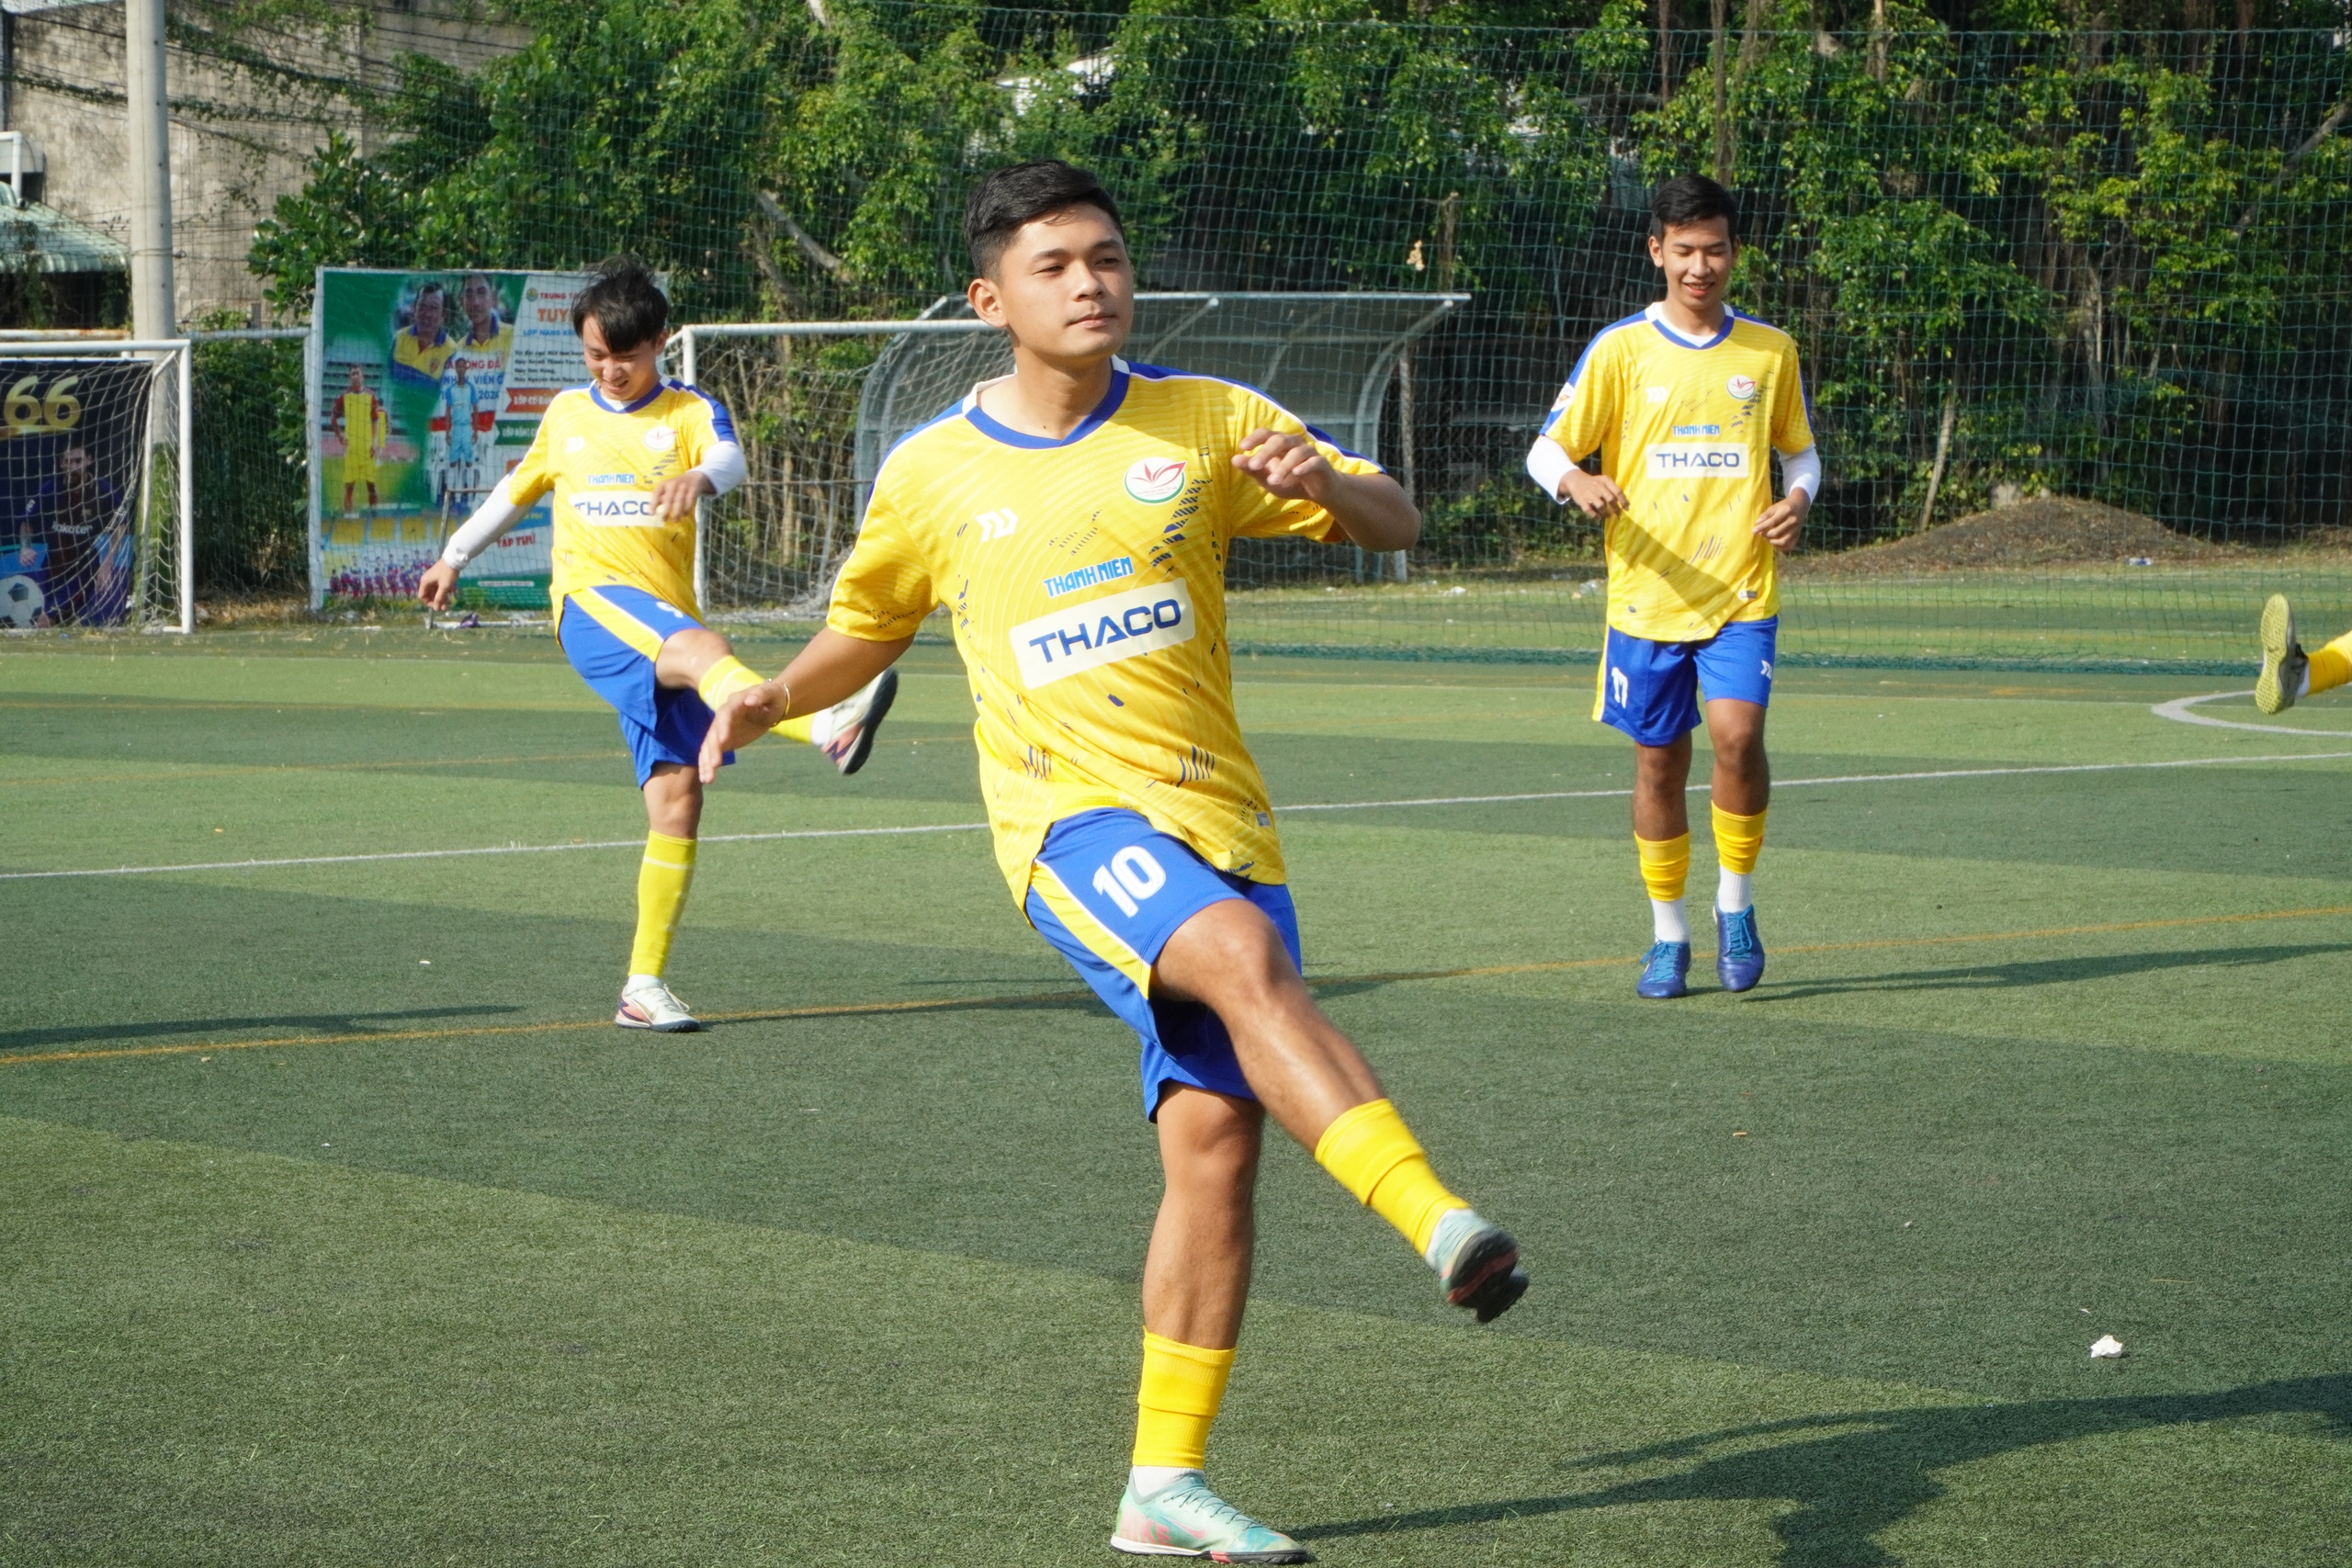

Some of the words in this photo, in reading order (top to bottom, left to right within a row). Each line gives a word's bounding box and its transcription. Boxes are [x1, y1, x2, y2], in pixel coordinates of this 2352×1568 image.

[1656, 453, 1739, 468] THACO
[1044, 566, 1098, 597] THANH
[1029, 599, 1182, 663] THACO
[1611, 667, 1628, 708] 17
[1092, 845, 1166, 919] 10
